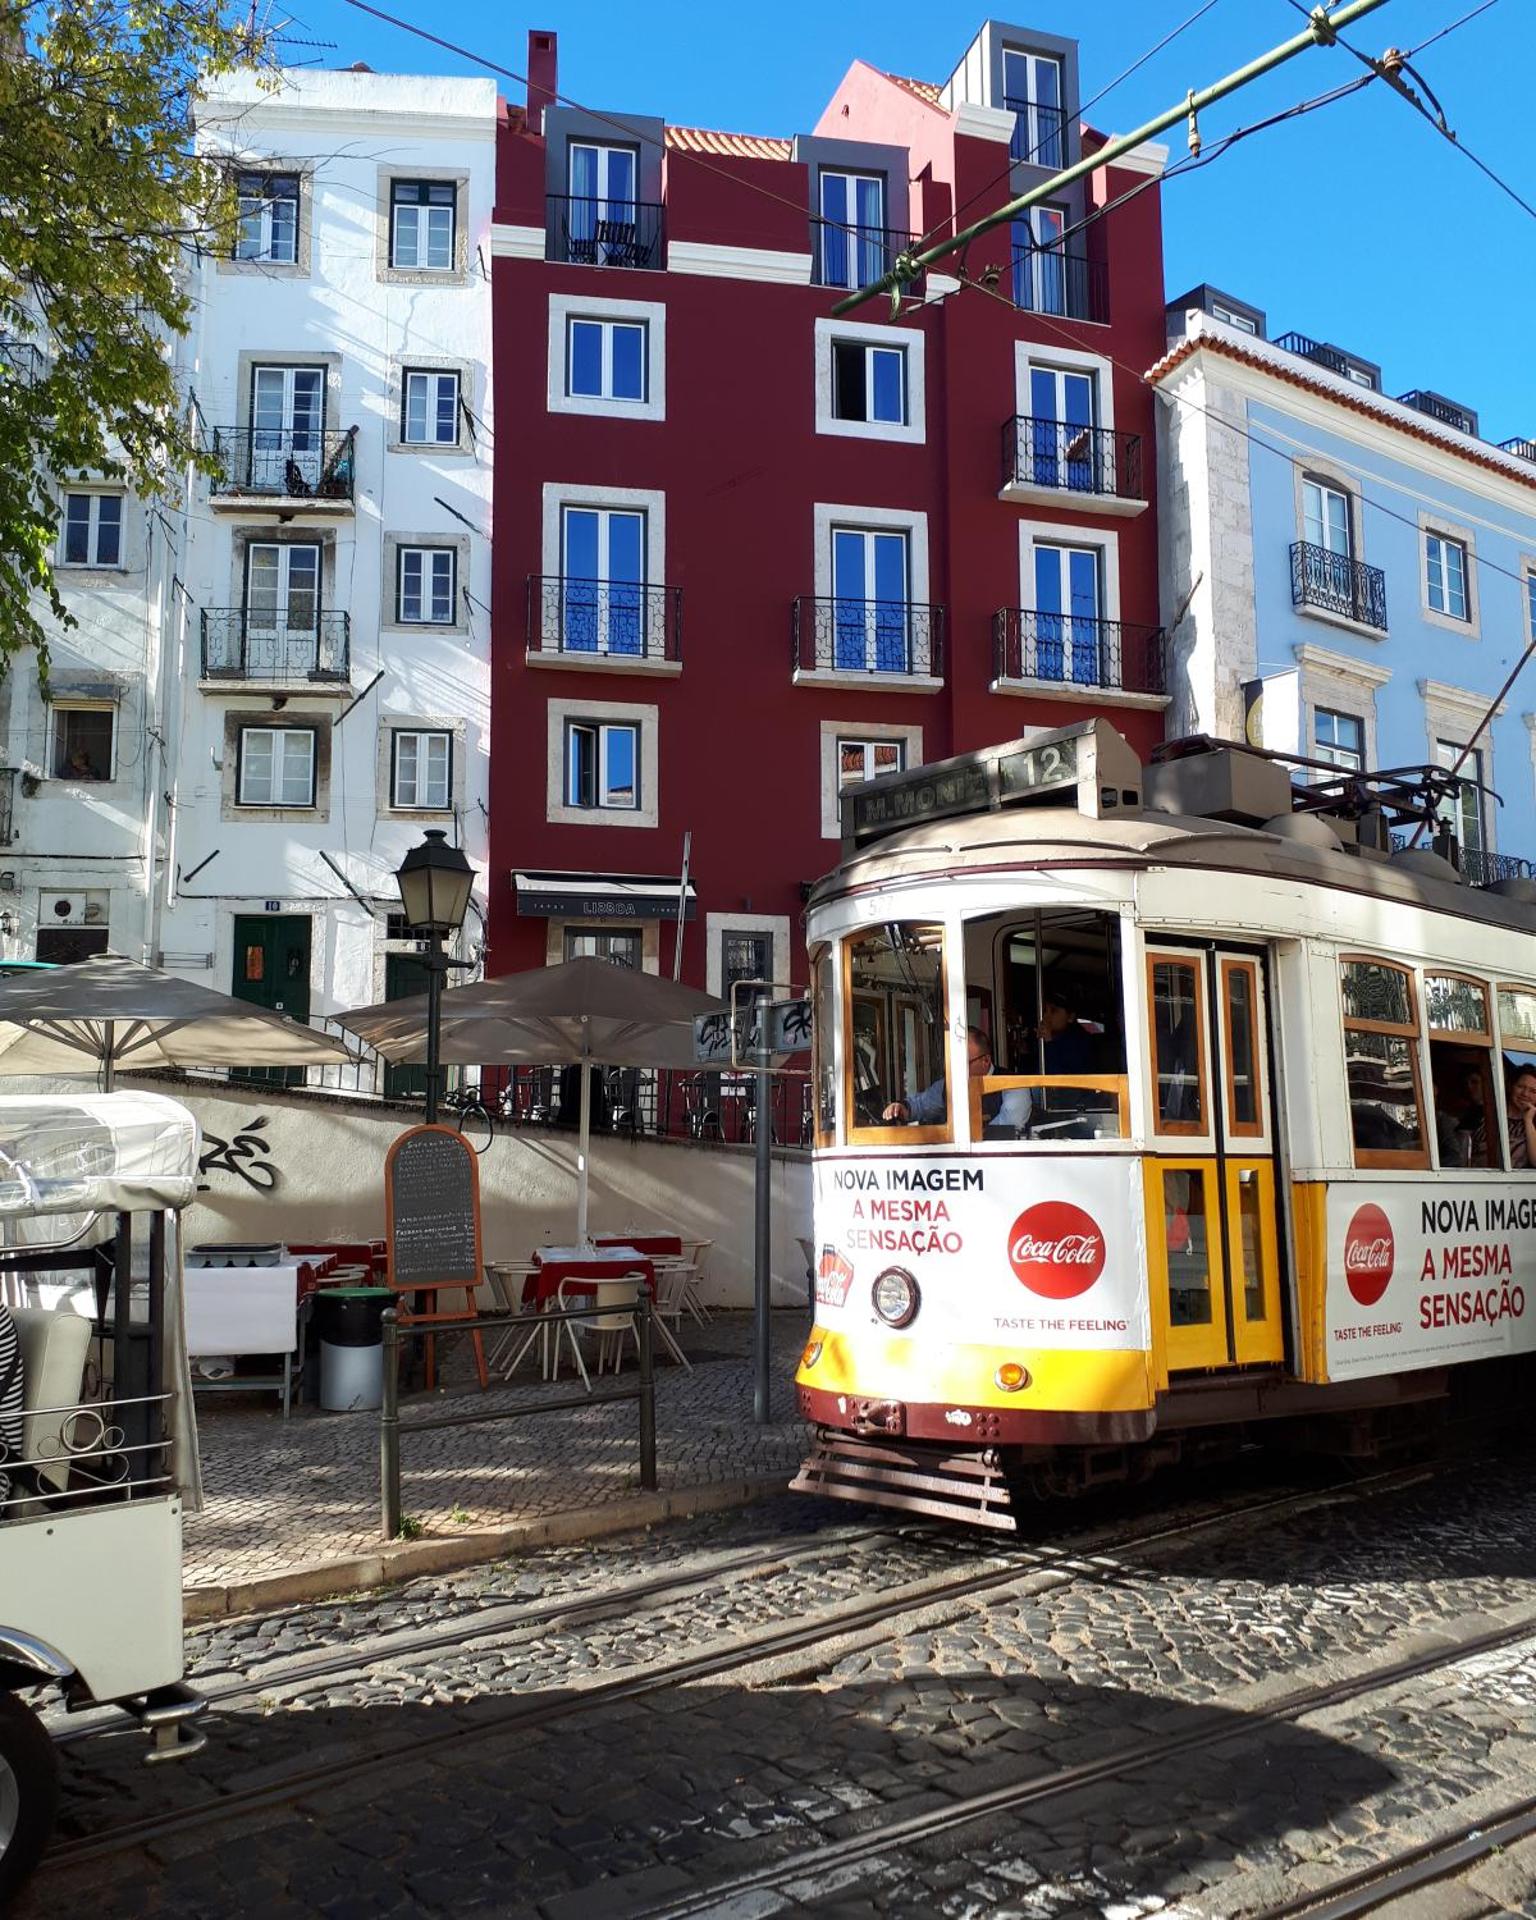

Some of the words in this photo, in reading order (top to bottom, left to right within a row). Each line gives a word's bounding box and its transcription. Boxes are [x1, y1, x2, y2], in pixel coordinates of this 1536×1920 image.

[1023, 746, 1064, 786] 12
[834, 1169, 880, 1191] NOVA
[886, 1169, 984, 1192] IMAGEM
[852, 1199, 865, 1220] A
[870, 1200, 951, 1222] MESMA
[1422, 1200, 1480, 1234] NOVA
[846, 1225, 964, 1256] SENSAÇÃO
[1012, 1234, 1100, 1264] Coca-Cola
[1347, 1239, 1391, 1269] Coca-Cola
[1420, 1248, 1436, 1281] A
[1442, 1243, 1513, 1279] MESMA
[1420, 1279, 1525, 1330] SENSAÇÃO
[993, 1317, 1035, 1330] TASTE
[1039, 1318, 1066, 1331] THE
[1334, 1328, 1357, 1341] TASTE
[1358, 1326, 1372, 1338] THE
